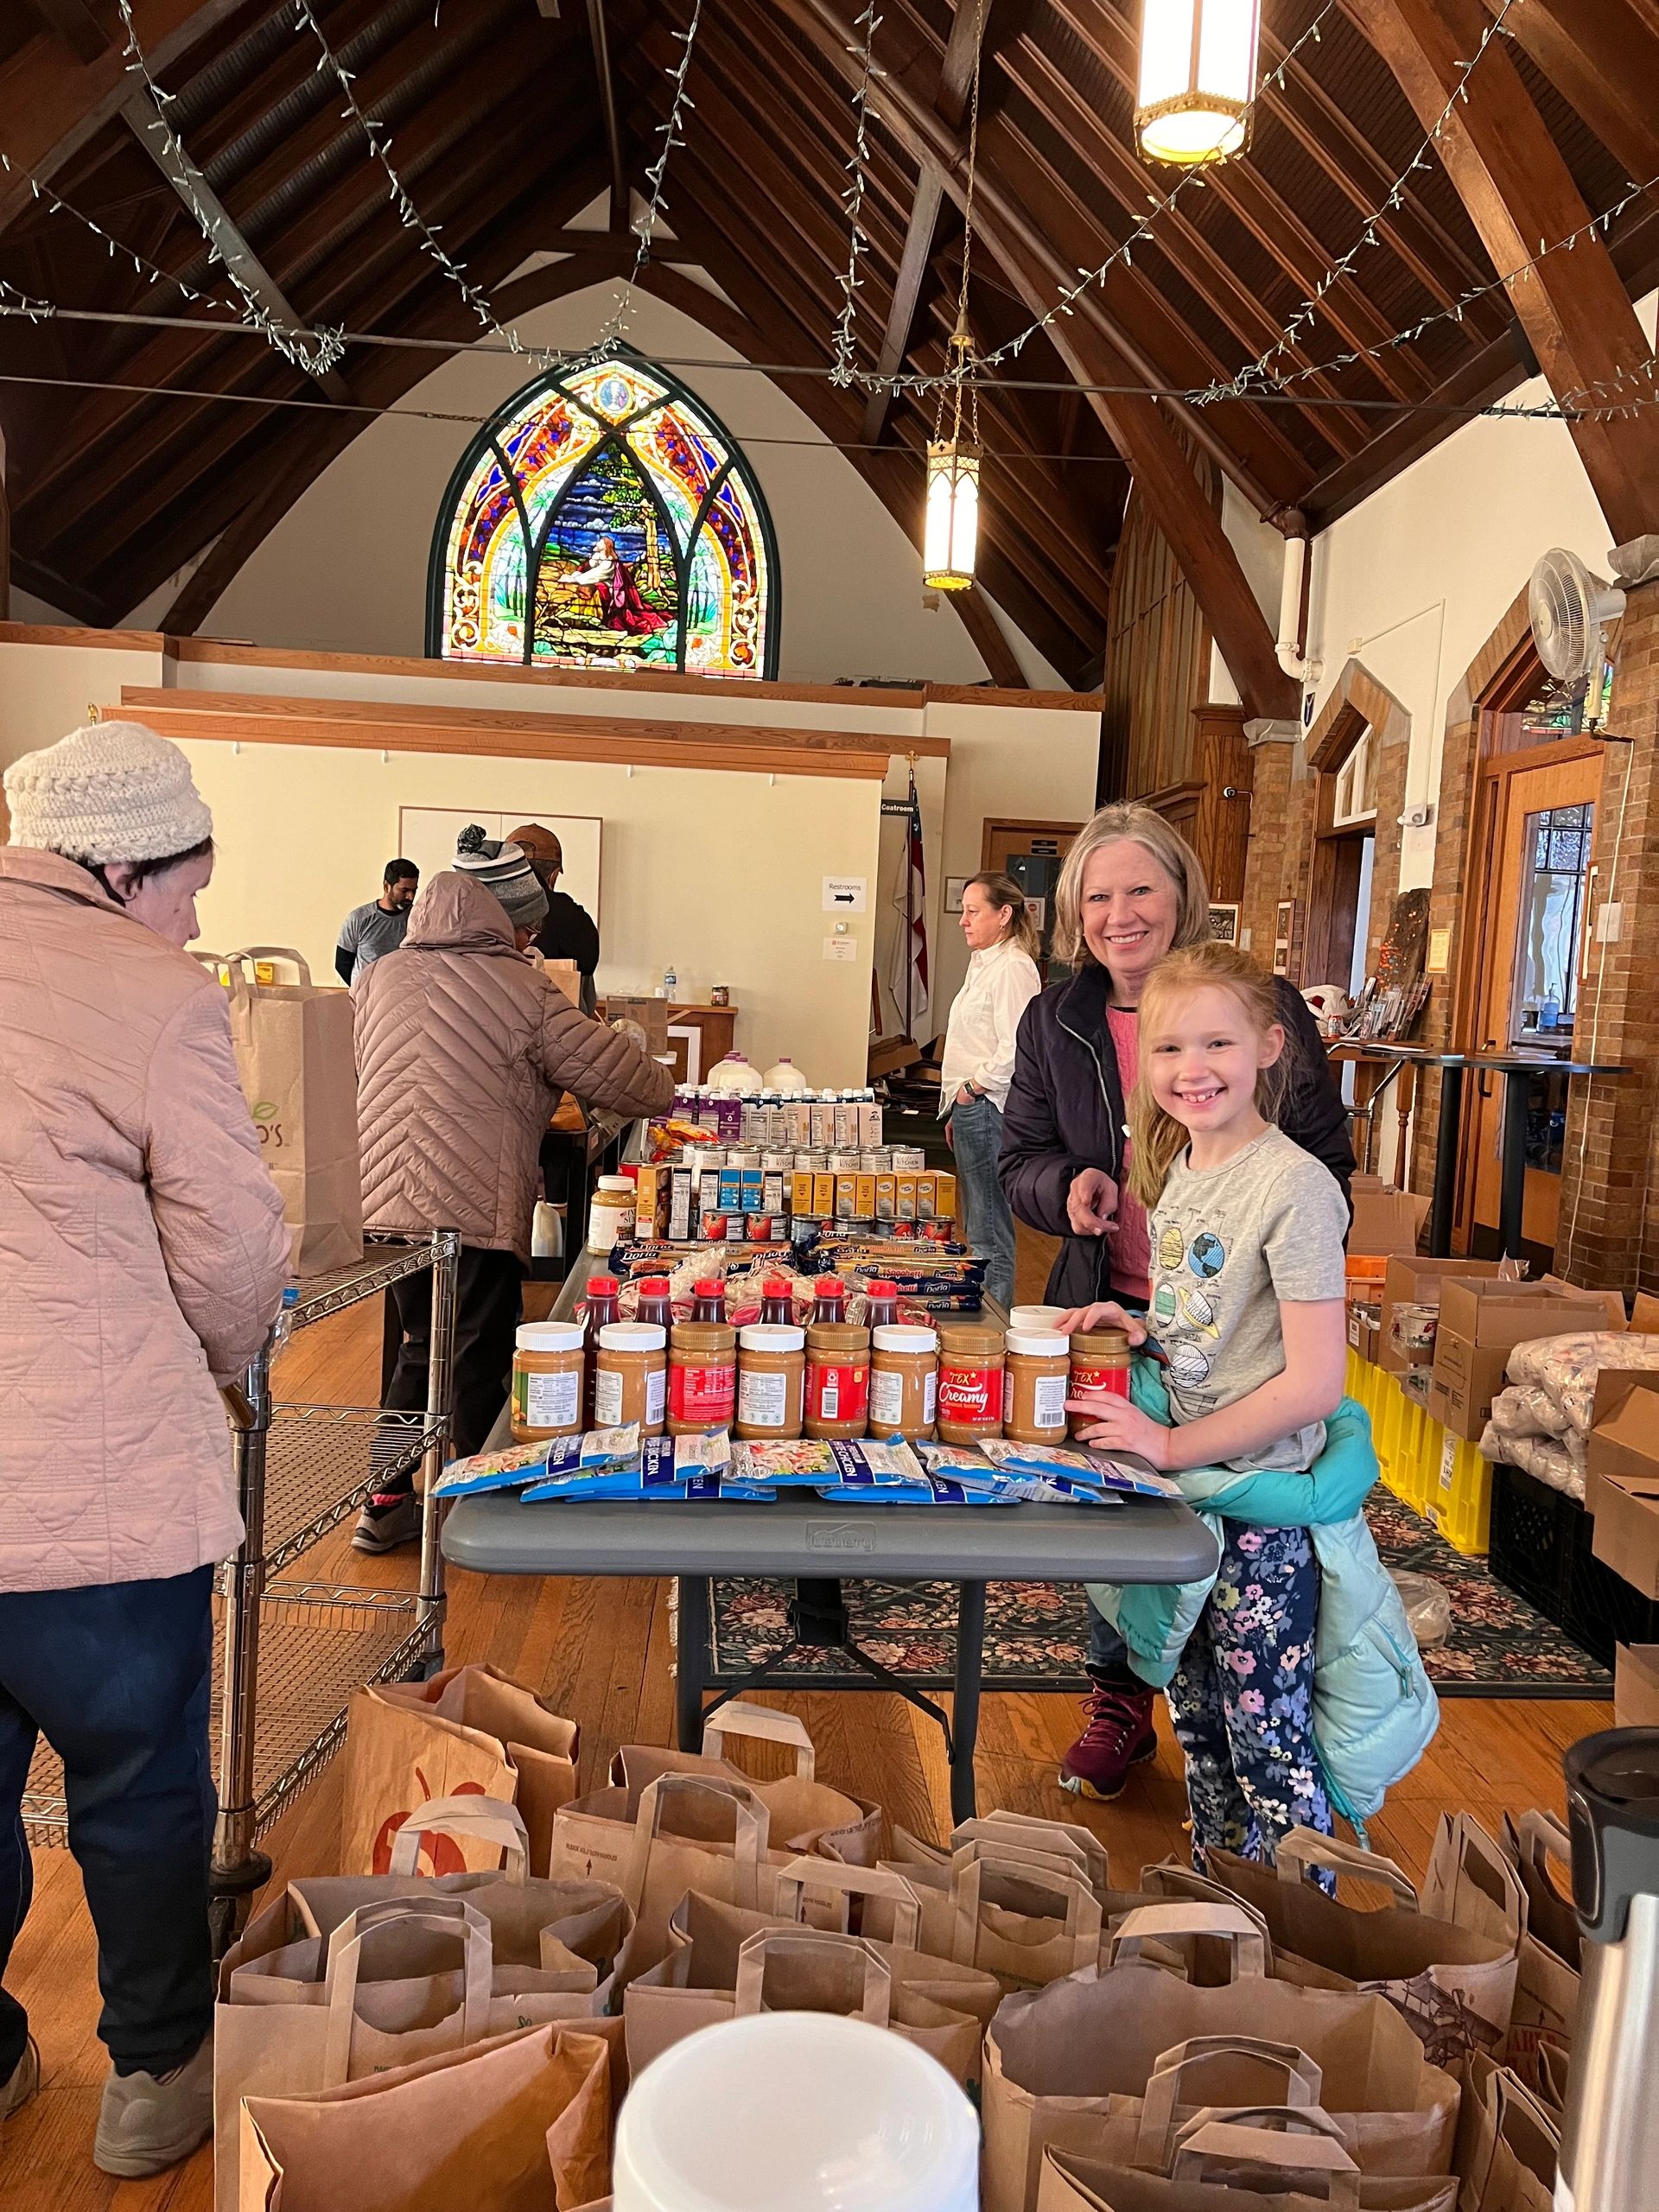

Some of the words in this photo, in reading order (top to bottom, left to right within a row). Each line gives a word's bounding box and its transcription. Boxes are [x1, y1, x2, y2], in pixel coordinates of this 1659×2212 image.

[881, 804, 914, 812] Coatroom
[855, 1265, 878, 1274] Doria
[887, 1266, 924, 1277] Spaghetti
[926, 1284, 948, 1293] Doria
[928, 1300, 950, 1309] Doria
[938, 1381, 988, 1413] Creamy
